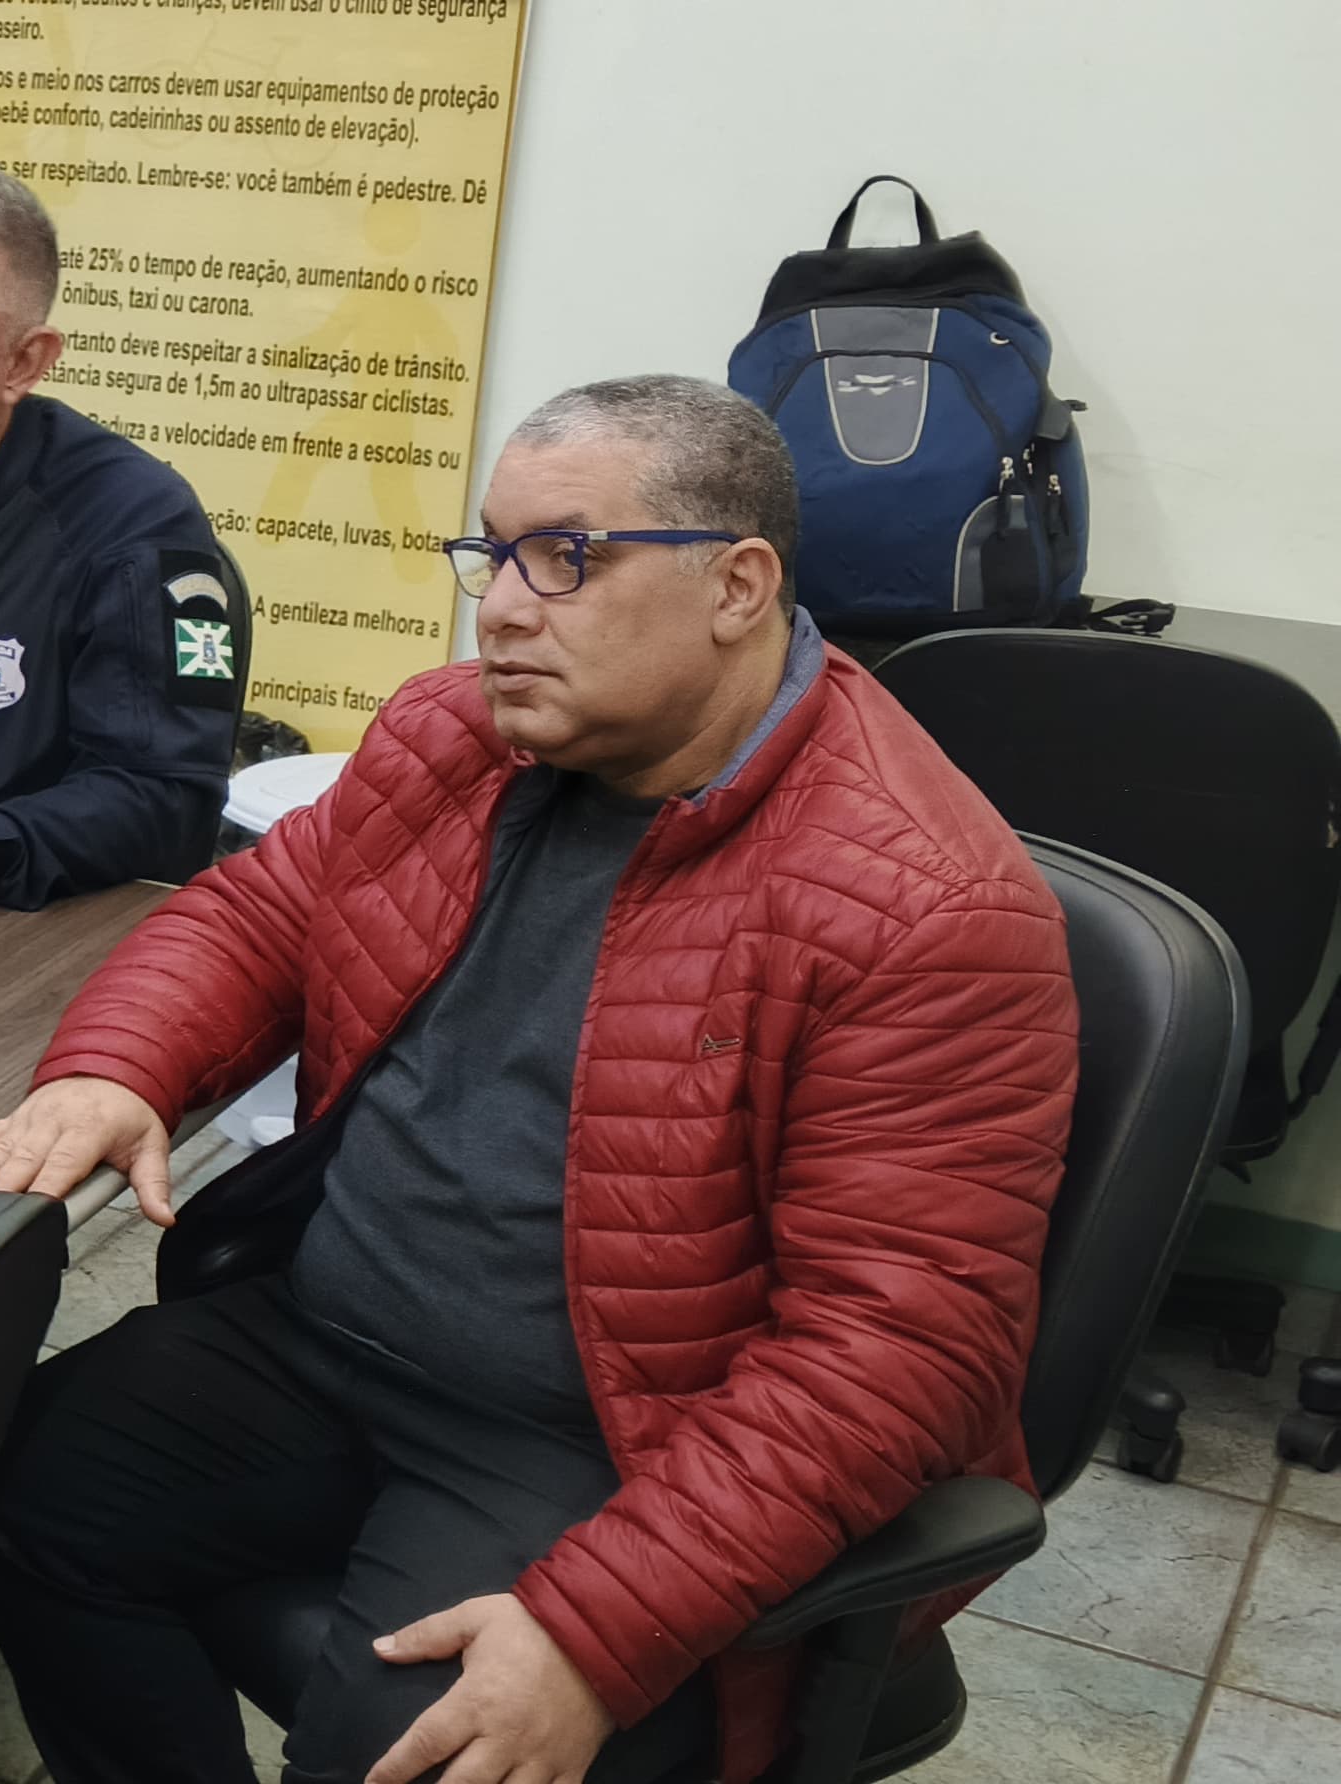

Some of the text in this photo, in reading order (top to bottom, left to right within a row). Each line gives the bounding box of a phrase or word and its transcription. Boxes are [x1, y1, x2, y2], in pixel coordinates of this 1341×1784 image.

[290, 0, 323, 12] usar
[329, 0, 340, 13] o
[345, 0, 387, 14] cinto
[392, 0, 413, 15] de
[417, 0, 507, 25] segurança
[18, 72, 27, 89] e
[31, 67, 70, 92] meio
[75, 72, 104, 93] nos
[109, 74, 160, 95] carros
[166, 72, 218, 97] devem
[224, 78, 262, 98] usar
[267, 76, 388, 108] equipamentso
[393, 81, 414, 105] de
[419, 84, 499, 114] proteção
[33, 101, 105, 131] conforto,
[109, 105, 203, 133] cadeirinhas
[208, 112, 229, 132] ou
[234, 112, 301, 136] assento
[305, 114, 326, 138] de
[330, 115, 419, 148] elevação).
[12, 159, 37, 179] ser
[41, 159, 131, 187] respeitado.
[138, 161, 231, 190] Lembre-se:
[236, 168, 277, 192] você
[282, 171, 351, 197] também
[357, 173, 368, 198] é
[372, 176, 456, 204] pedestre.
[462, 179, 487, 204] Dê
[59, 248, 84, 270] até
[88, 247, 123, 272] 25%
[129, 252, 139, 272] o
[144, 251, 196, 281] tempo
[202, 255, 222, 279] de
[228, 259, 291, 288] reação,
[296, 266, 408, 293] aumentando
[415, 274, 425, 294] o
[432, 270, 478, 297] risco
[62, 284, 123, 311] ônibus,
[129, 287, 158, 309] taxi
[163, 292, 184, 311] ou
[189, 294, 253, 317] carona.
[121, 332, 159, 357] deve
[164, 339, 242, 366] respeitar
[247, 346, 256, 365] a
[262, 344, 360, 377] sinalização
[367, 351, 388, 375] de
[395, 354, 470, 383] trânsito.
[106, 370, 162, 395] segura
[167, 371, 188, 394] de
[194, 373, 234, 400] 1,5m
[240, 380, 261, 400] ao
[267, 378, 368, 410] ultrapassar
[373, 389, 454, 417] ciclistas.
[89, 413, 460, 469] duza a velocidade em frente a escolas ou
[256, 514, 337, 547] capacete,
[343, 521, 396, 551] luvas,
[252, 595, 439, 638] A gentileza melhora a
[251, 677, 337, 708] principais
